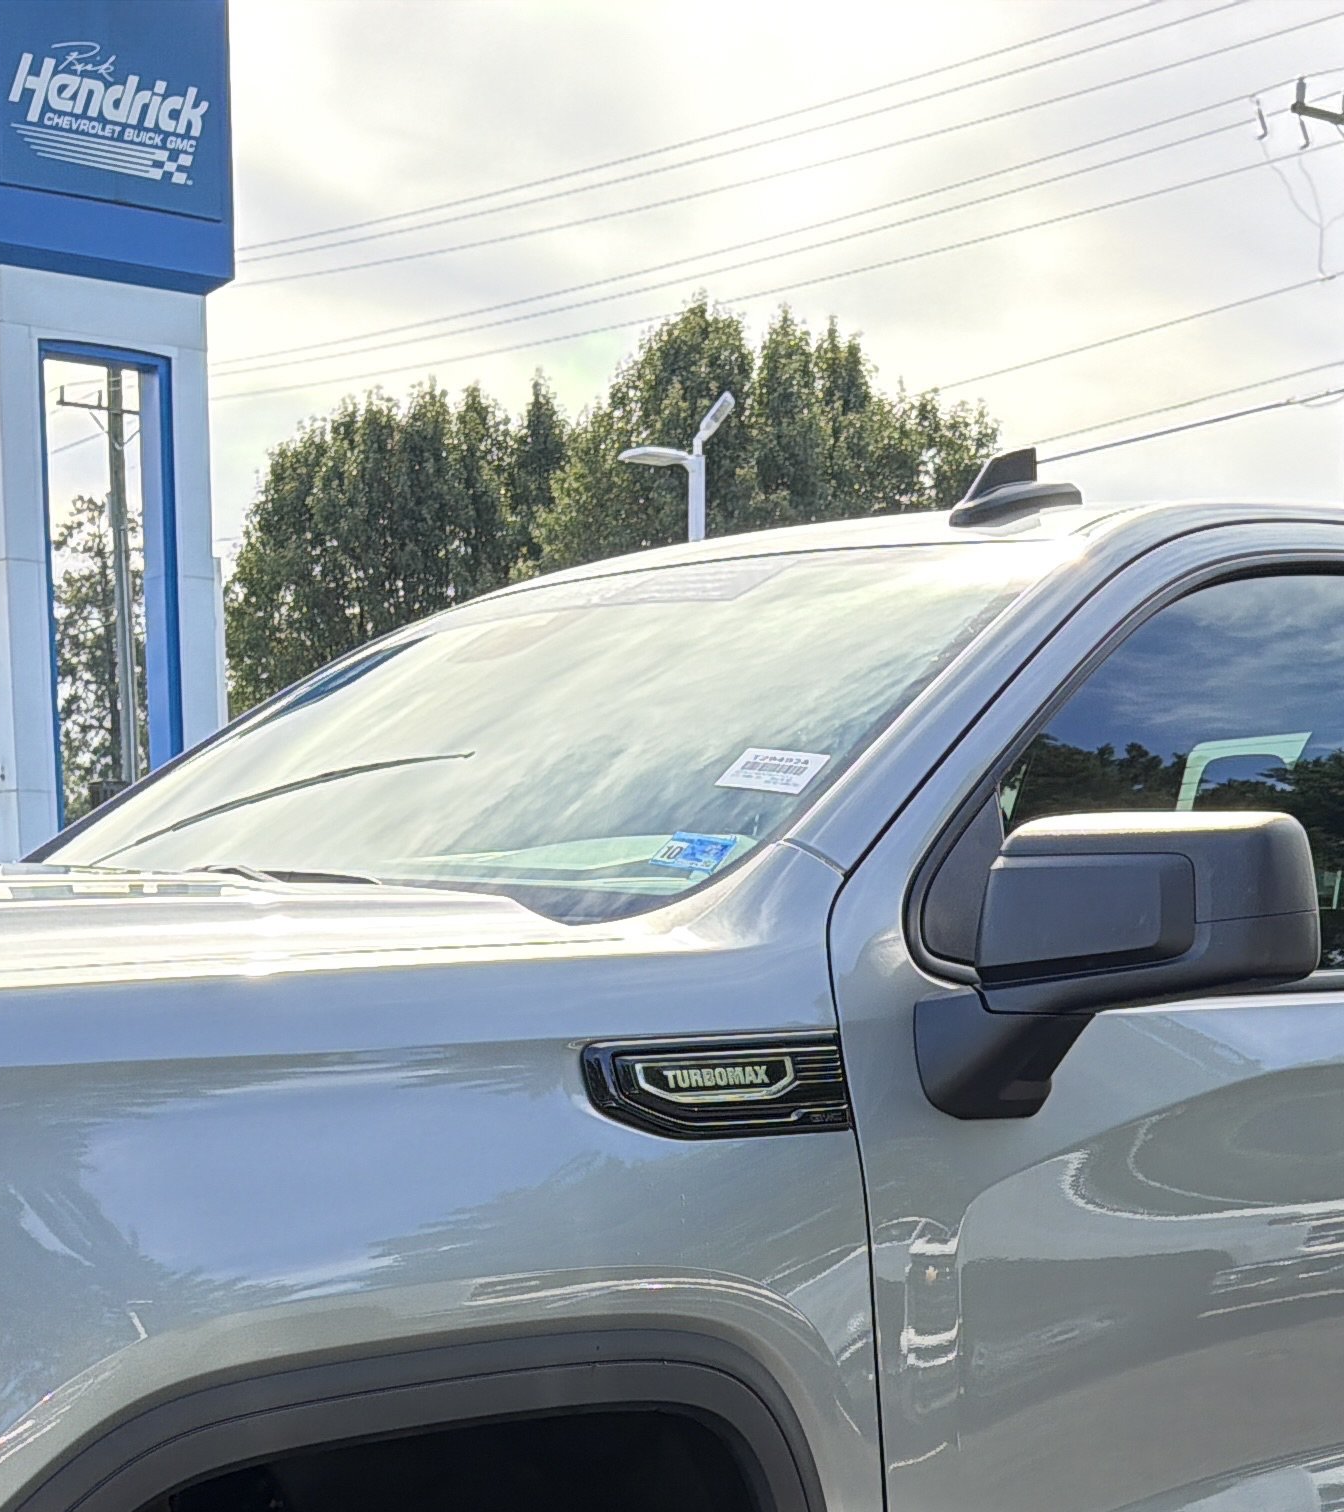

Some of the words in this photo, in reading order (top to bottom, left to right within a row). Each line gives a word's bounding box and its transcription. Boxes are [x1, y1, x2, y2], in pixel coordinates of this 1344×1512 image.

[8, 52, 209, 137] Hendrick
[44, 112, 122, 139] CHEVROLET
[123, 127, 164, 146] BUICK
[167, 136, 197, 153] GMC
[660, 844, 684, 860] 10
[662, 1065, 770, 1089] TURBOMAX
